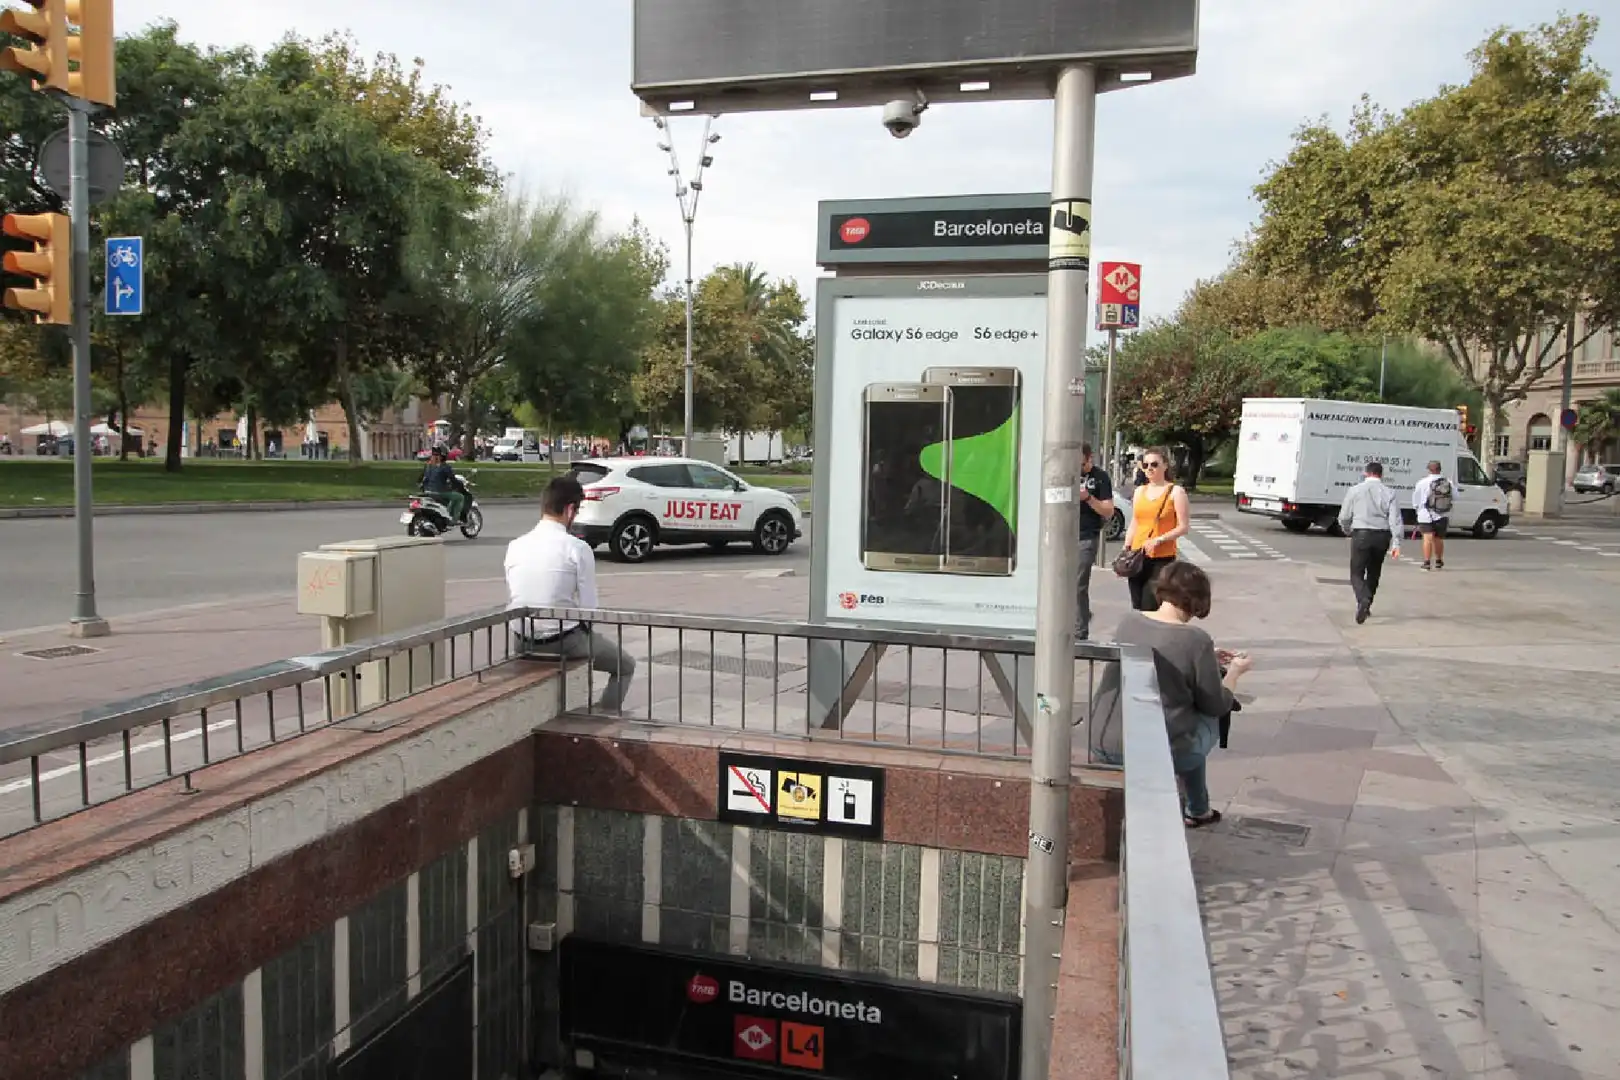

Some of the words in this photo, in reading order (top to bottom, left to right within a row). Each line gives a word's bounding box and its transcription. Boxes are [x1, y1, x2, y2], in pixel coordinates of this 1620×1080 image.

[934, 219, 1044, 237] Barceloneta
[1115, 272, 1129, 285] M
[851, 327, 903, 343] Galaxy
[906, 327, 923, 340] S6
[925, 329, 958, 342] edge
[974, 326, 991, 340] S6
[663, 500, 708, 519] JUST
[709, 502, 742, 521] EAT
[692, 984, 716, 996] TMB
[729, 980, 882, 1024] Barceloneta
[748, 1030, 763, 1045] M
[787, 1029, 820, 1058] L4
